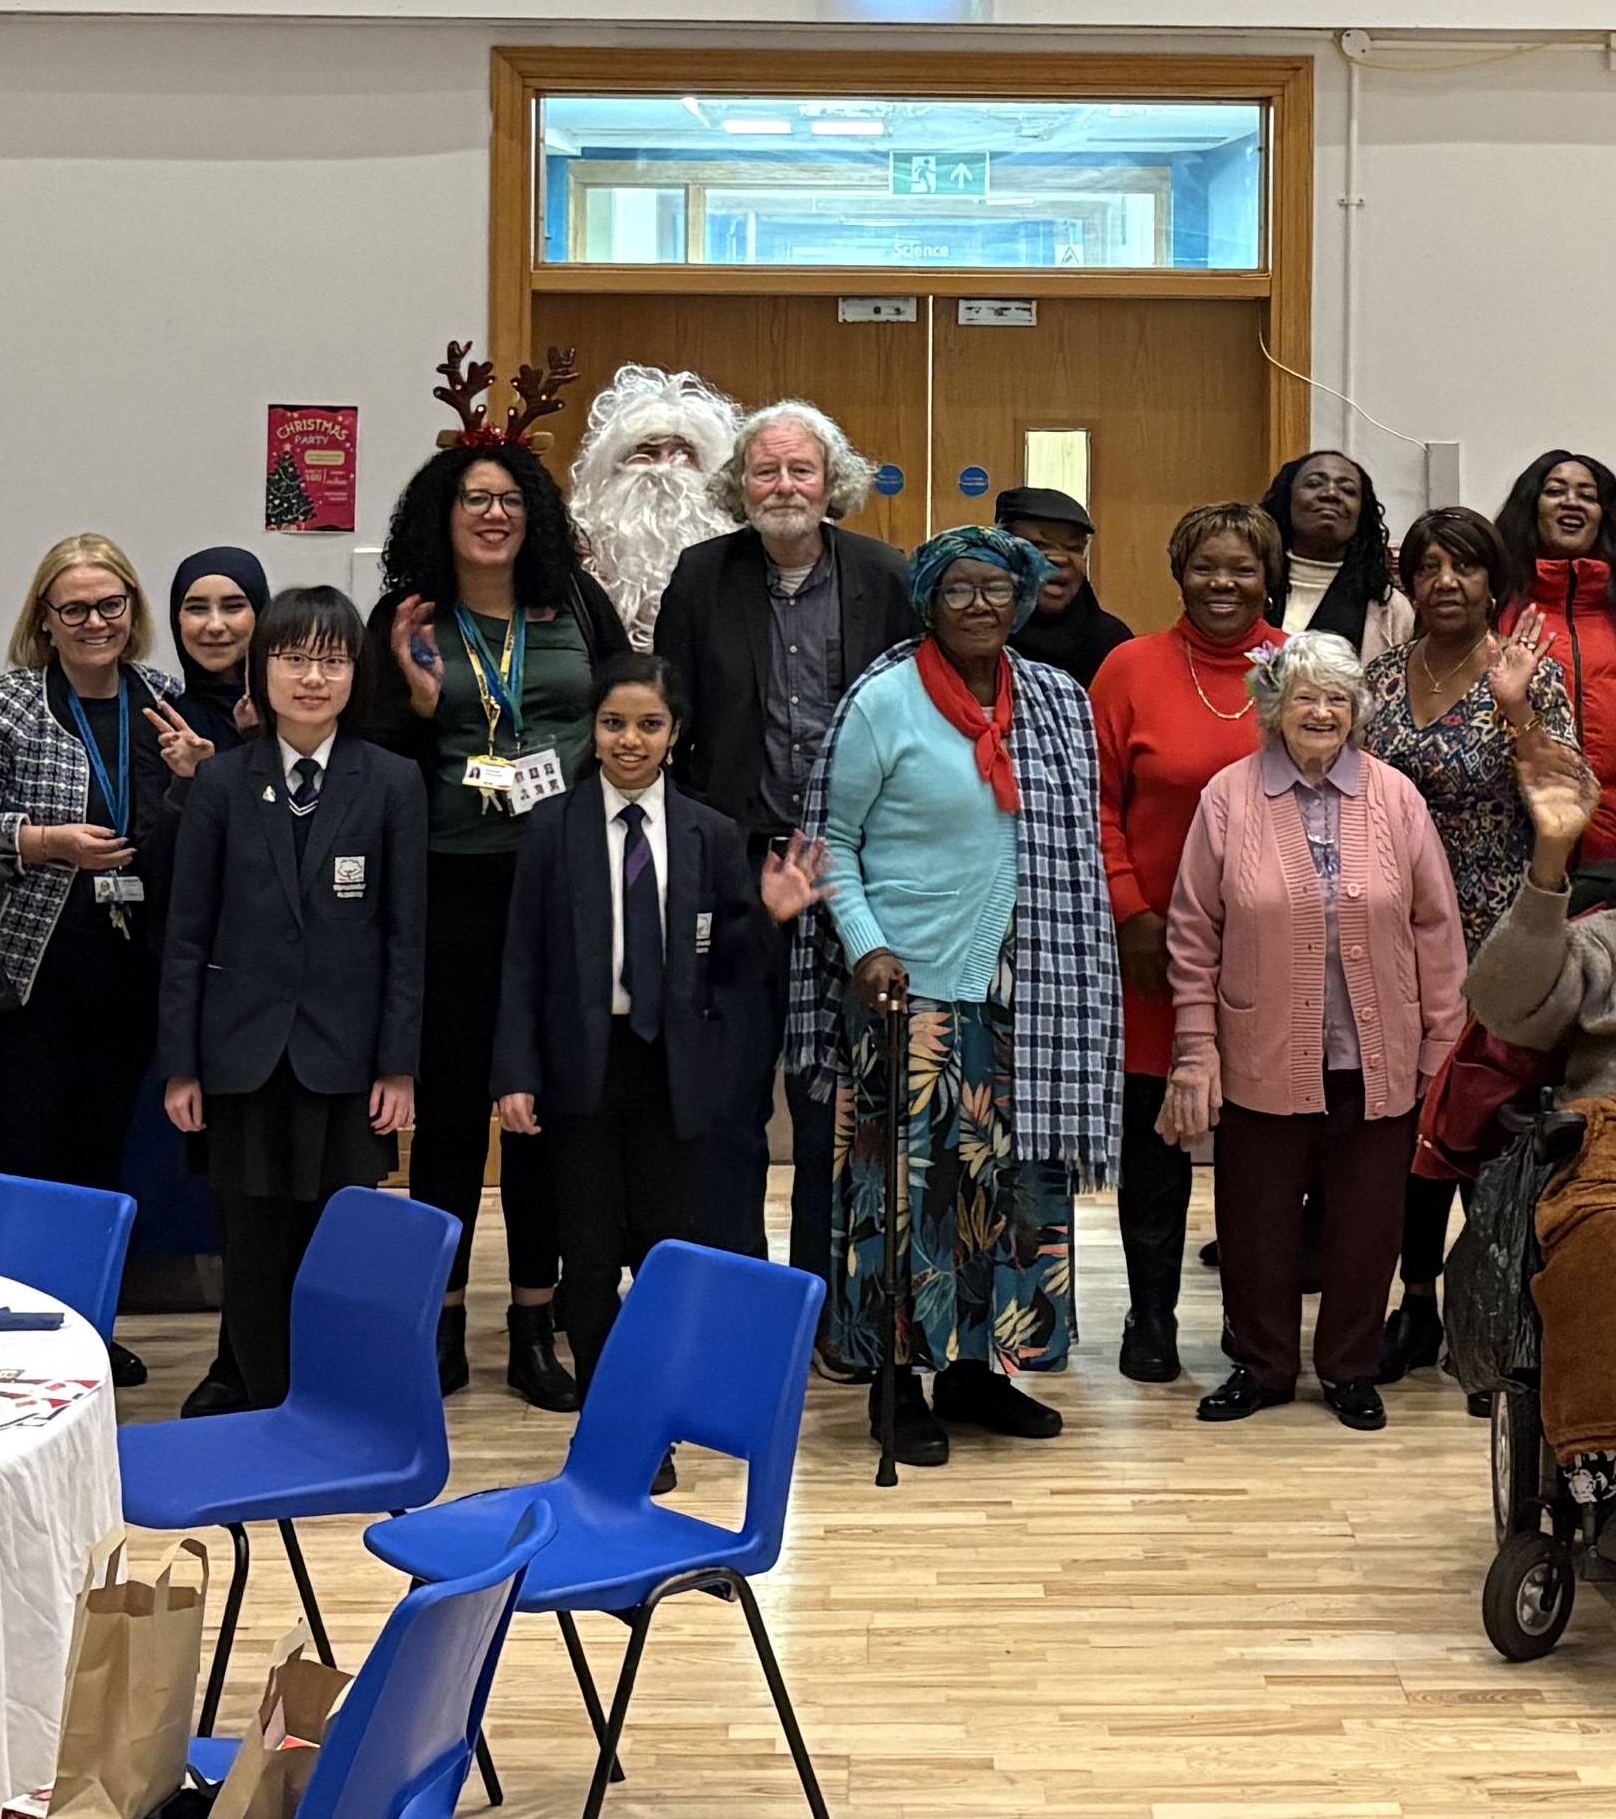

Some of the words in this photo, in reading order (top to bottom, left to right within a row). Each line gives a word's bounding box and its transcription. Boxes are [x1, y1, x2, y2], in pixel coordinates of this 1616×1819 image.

[893, 242, 949, 258] Science
[276, 418, 349, 441] CHRISTMAS
[294, 434, 329, 446] PARTY
